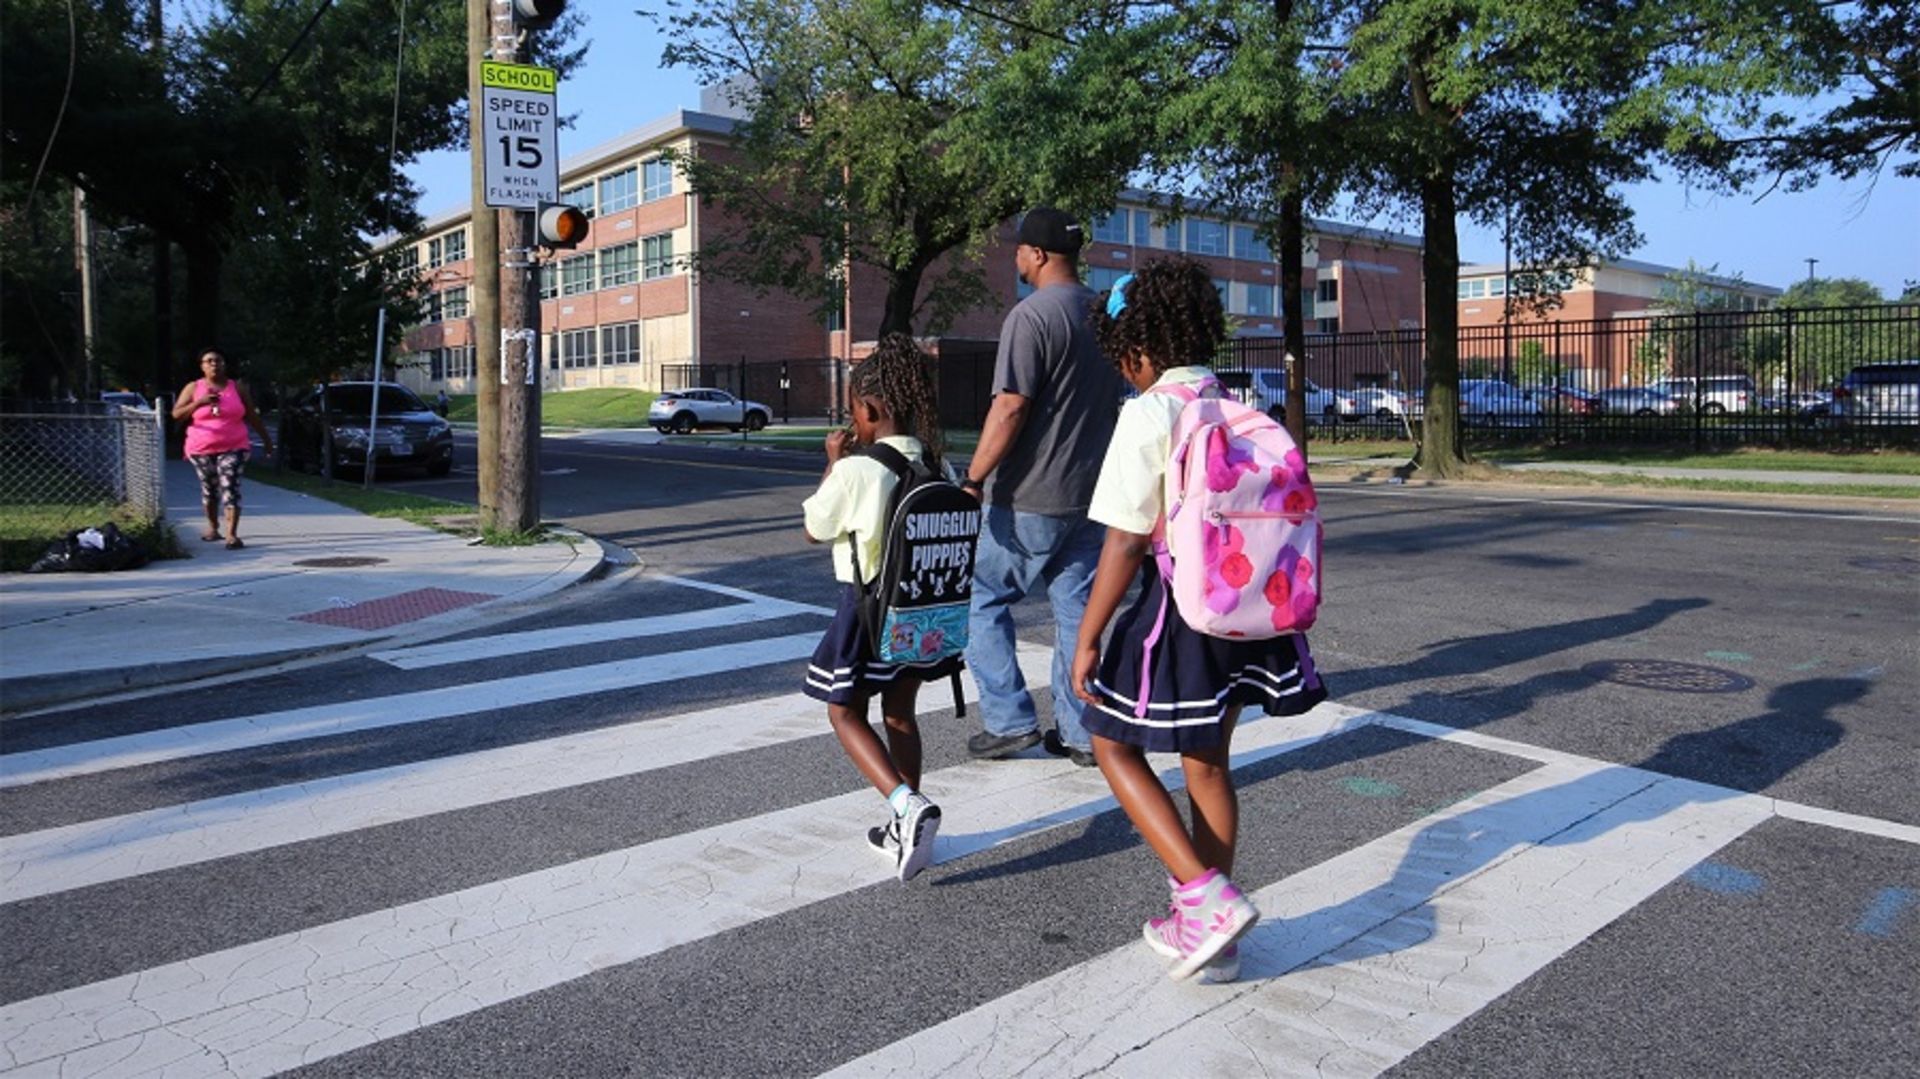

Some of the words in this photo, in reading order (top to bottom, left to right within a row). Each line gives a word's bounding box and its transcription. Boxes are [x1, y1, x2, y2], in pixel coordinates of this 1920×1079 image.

[486, 67, 551, 88] SCHOOL
[490, 97, 549, 116] SPEED
[496, 116, 542, 132] LIMIT
[499, 135, 542, 169] 15
[503, 176, 538, 187] WHEN
[490, 187, 552, 200] FLASHING
[911, 541, 971, 572] PUPPIES
